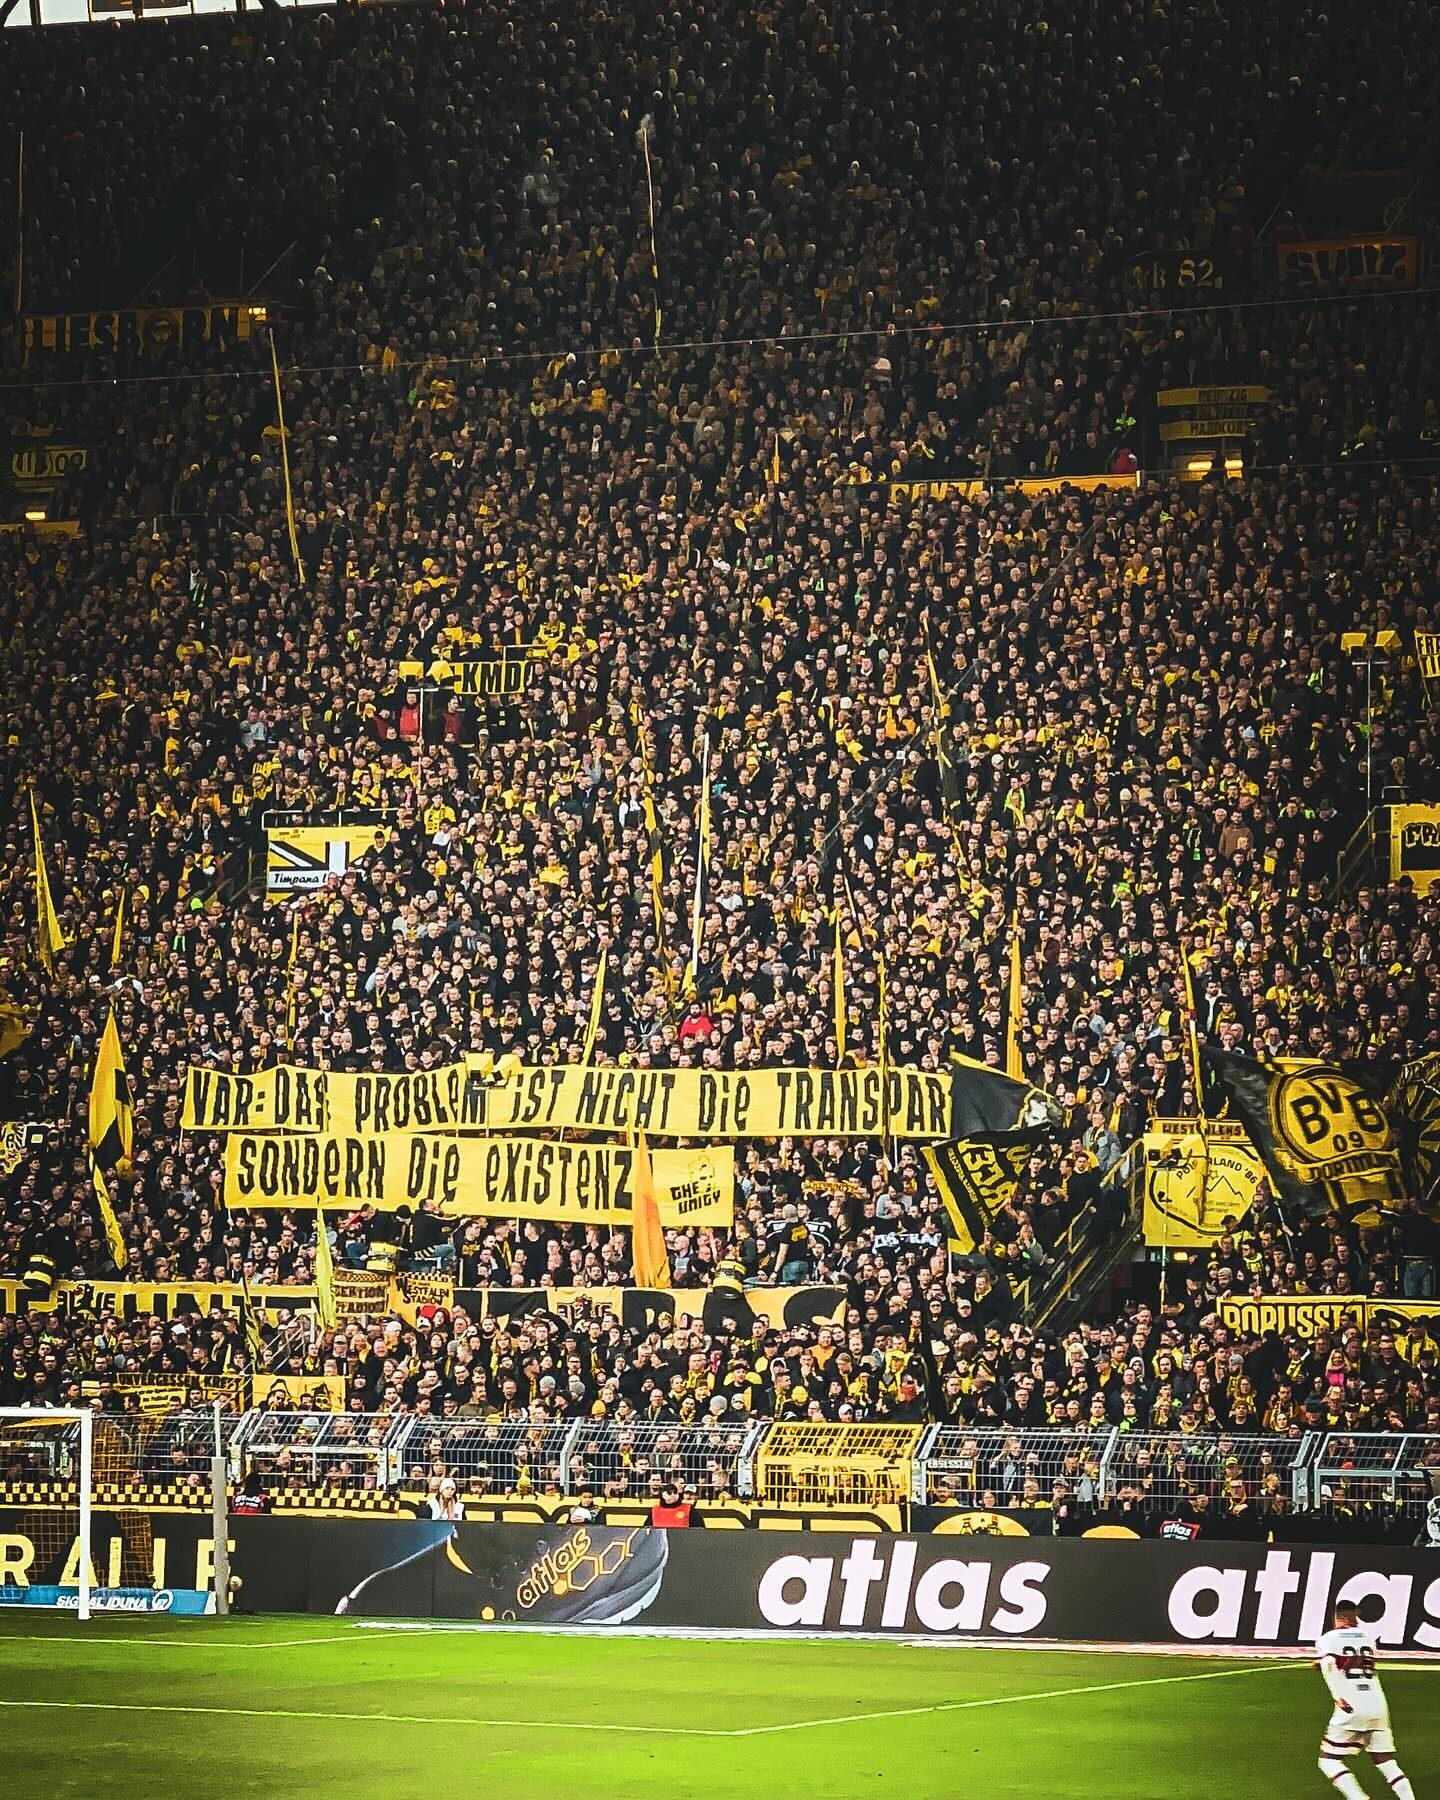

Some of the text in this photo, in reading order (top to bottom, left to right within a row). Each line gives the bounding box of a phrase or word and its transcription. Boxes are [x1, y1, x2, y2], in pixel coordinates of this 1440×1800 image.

[1290, 1080, 1386, 1145] BVB
[1332, 1131, 1365, 1153] 09
[517, 1528, 592, 1608] atlas
[758, 1539, 1051, 1634] atlas
[56, 1595, 104, 1608] SIGAL
